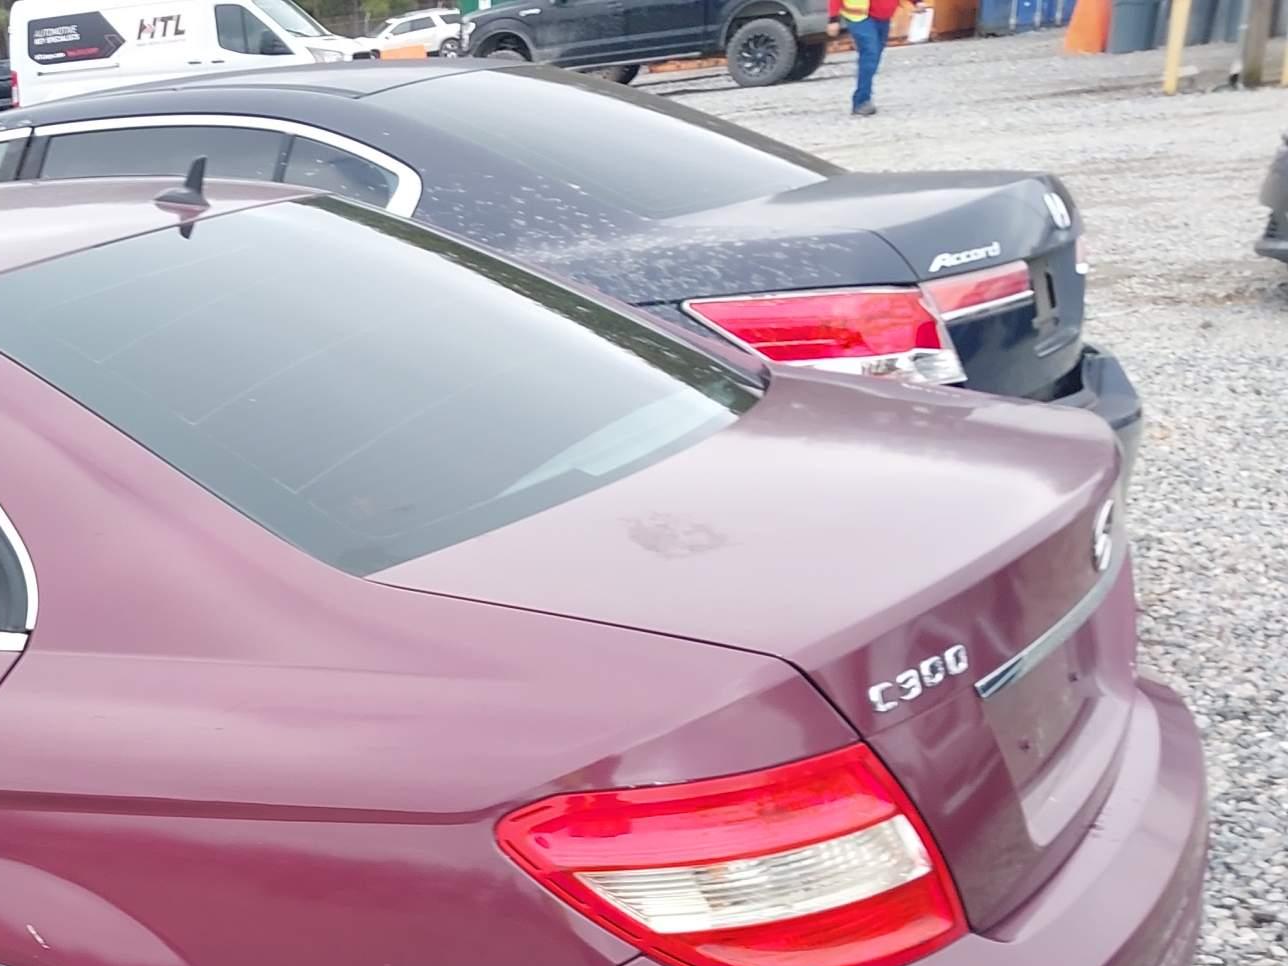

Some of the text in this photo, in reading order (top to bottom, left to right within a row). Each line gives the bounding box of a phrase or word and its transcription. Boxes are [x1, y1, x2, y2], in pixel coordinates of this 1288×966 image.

[137, 14, 185, 40] HTL
[928, 241, 1001, 273] Accord
[868, 644, 969, 712] C300
